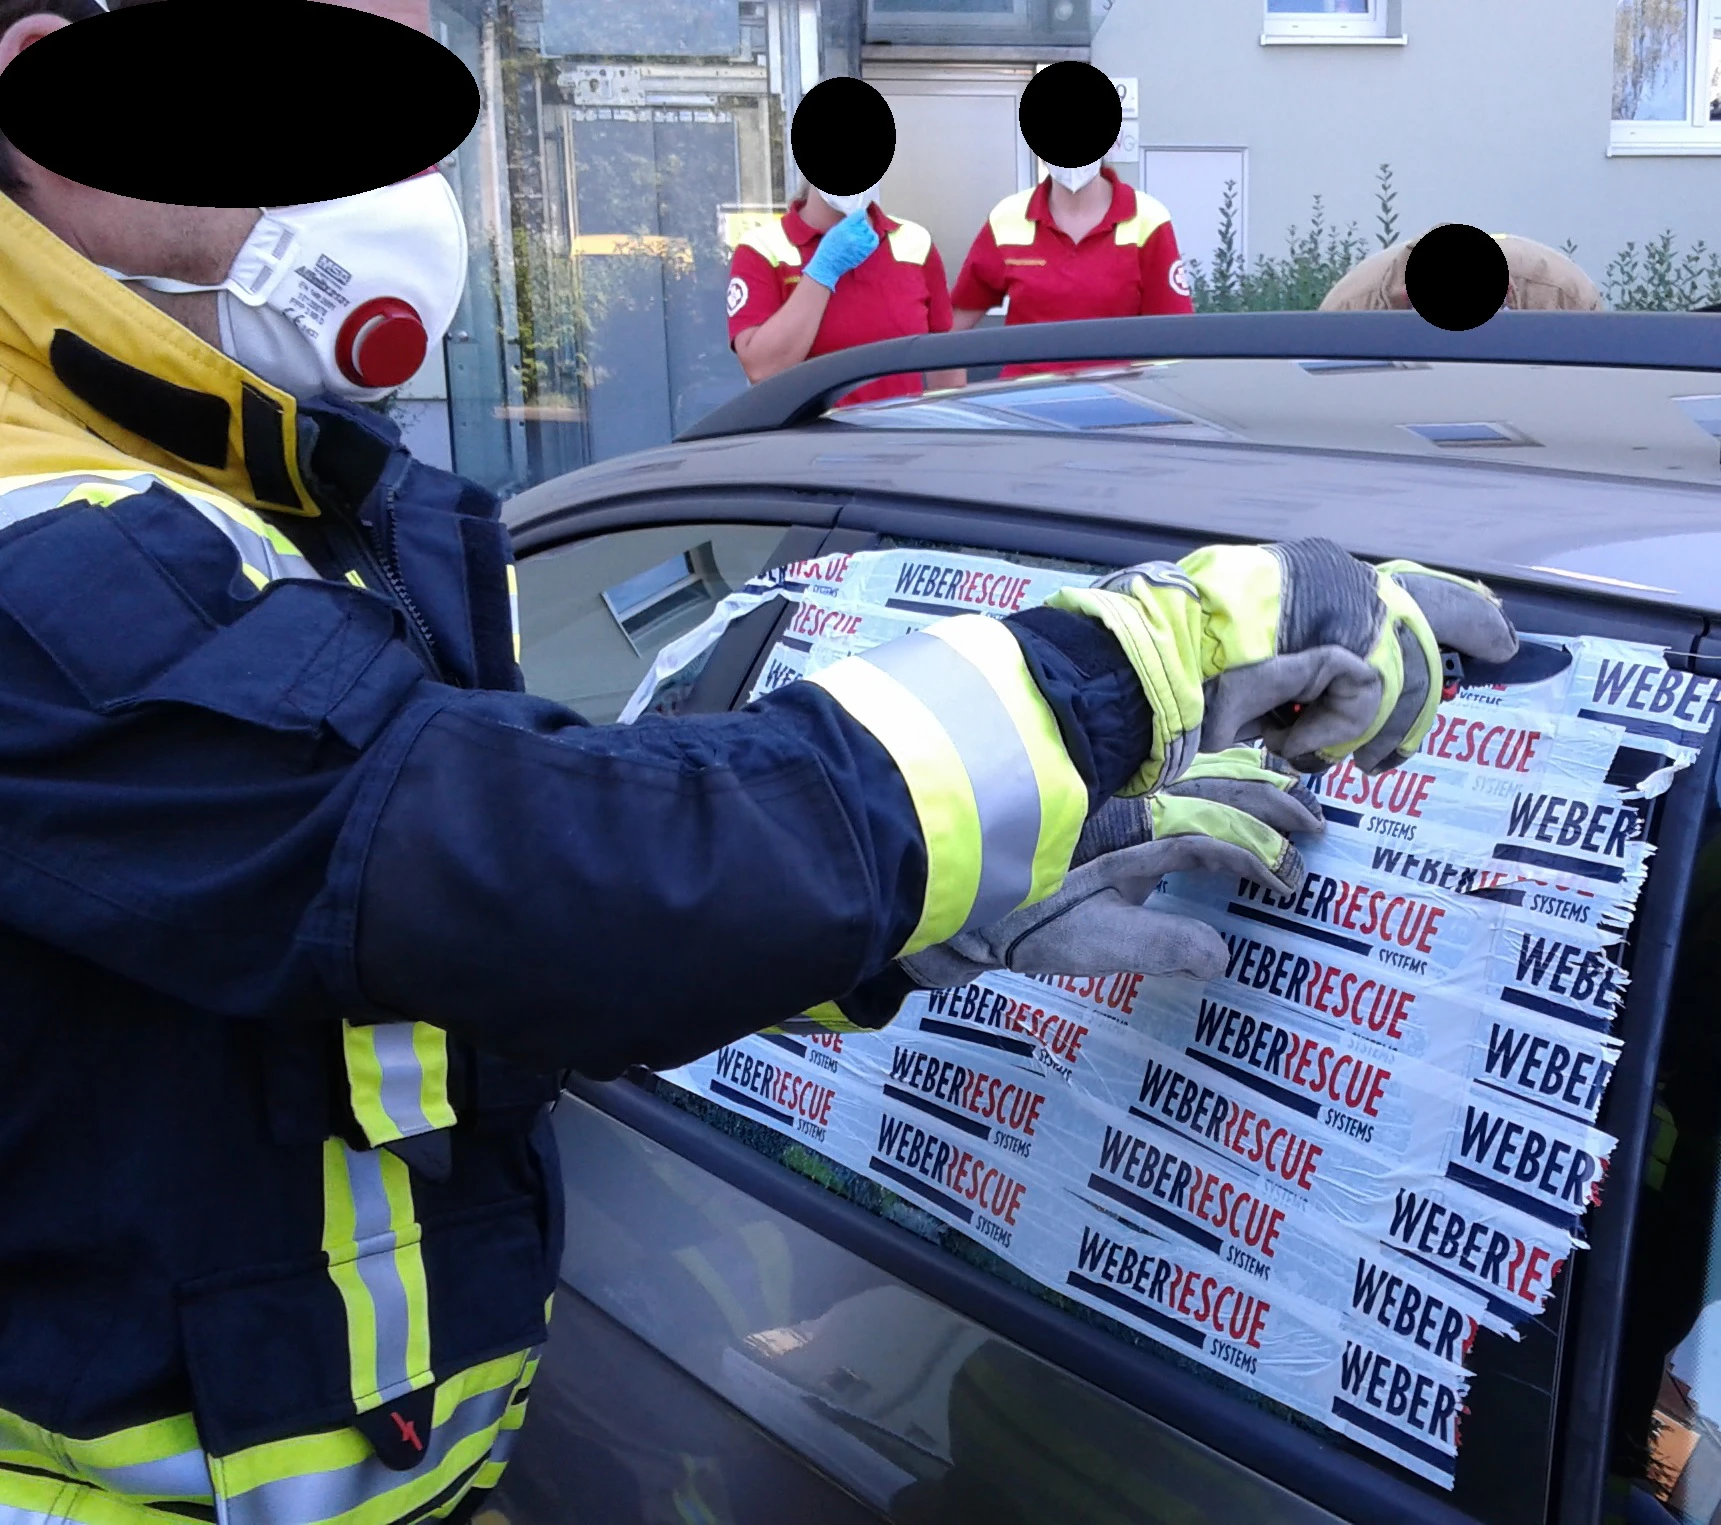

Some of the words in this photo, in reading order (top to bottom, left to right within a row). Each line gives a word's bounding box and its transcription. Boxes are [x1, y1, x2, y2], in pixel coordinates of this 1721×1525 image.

[1366, 815, 1417, 842] SYSTEMS
[1530, 893, 1591, 924] SYSTEMS
[809, 1050, 838, 1074] SYSTEMS
[797, 1119, 828, 1143] SYSTEMS
[1324, 1108, 1375, 1144] SYSTEMS
[993, 1131, 1032, 1158] SYSTEMS
[975, 1215, 1013, 1248] SYSTEMS
[1226, 1245, 1271, 1282] SYSTEMS
[1209, 1338, 1258, 1376] SYSTEMS
[1340, 1340, 1470, 1448] WEBER
